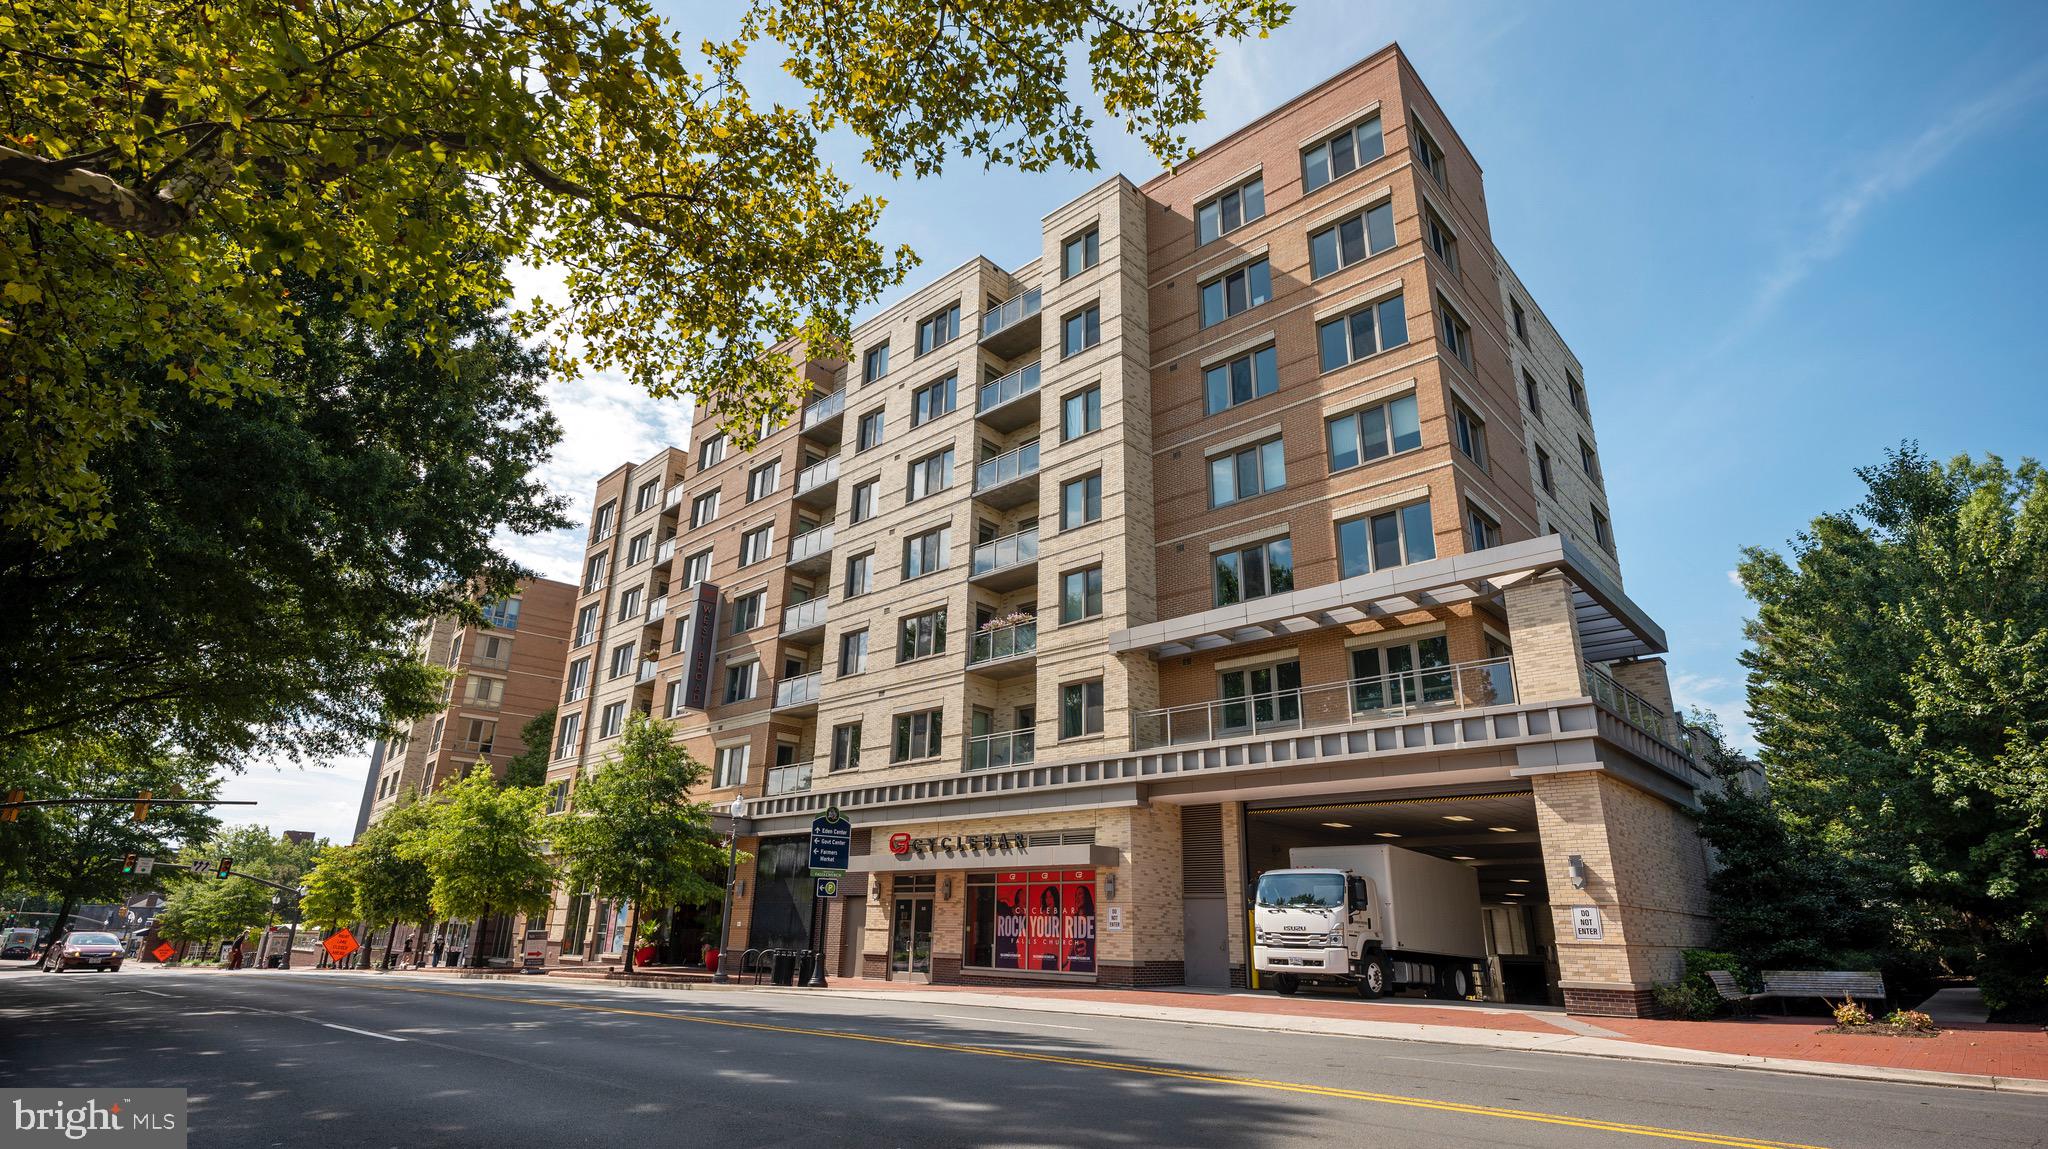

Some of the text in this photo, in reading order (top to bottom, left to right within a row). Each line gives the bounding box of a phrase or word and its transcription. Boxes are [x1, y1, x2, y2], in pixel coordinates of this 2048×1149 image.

[912, 832, 1025, 852] CYCLEBAR
[1580, 909, 1590, 917] DO
[1580, 918, 1593, 926] NOT
[997, 915, 1095, 939] ROCK YOUR RIDE
[1578, 927, 1598, 935] ENTER
